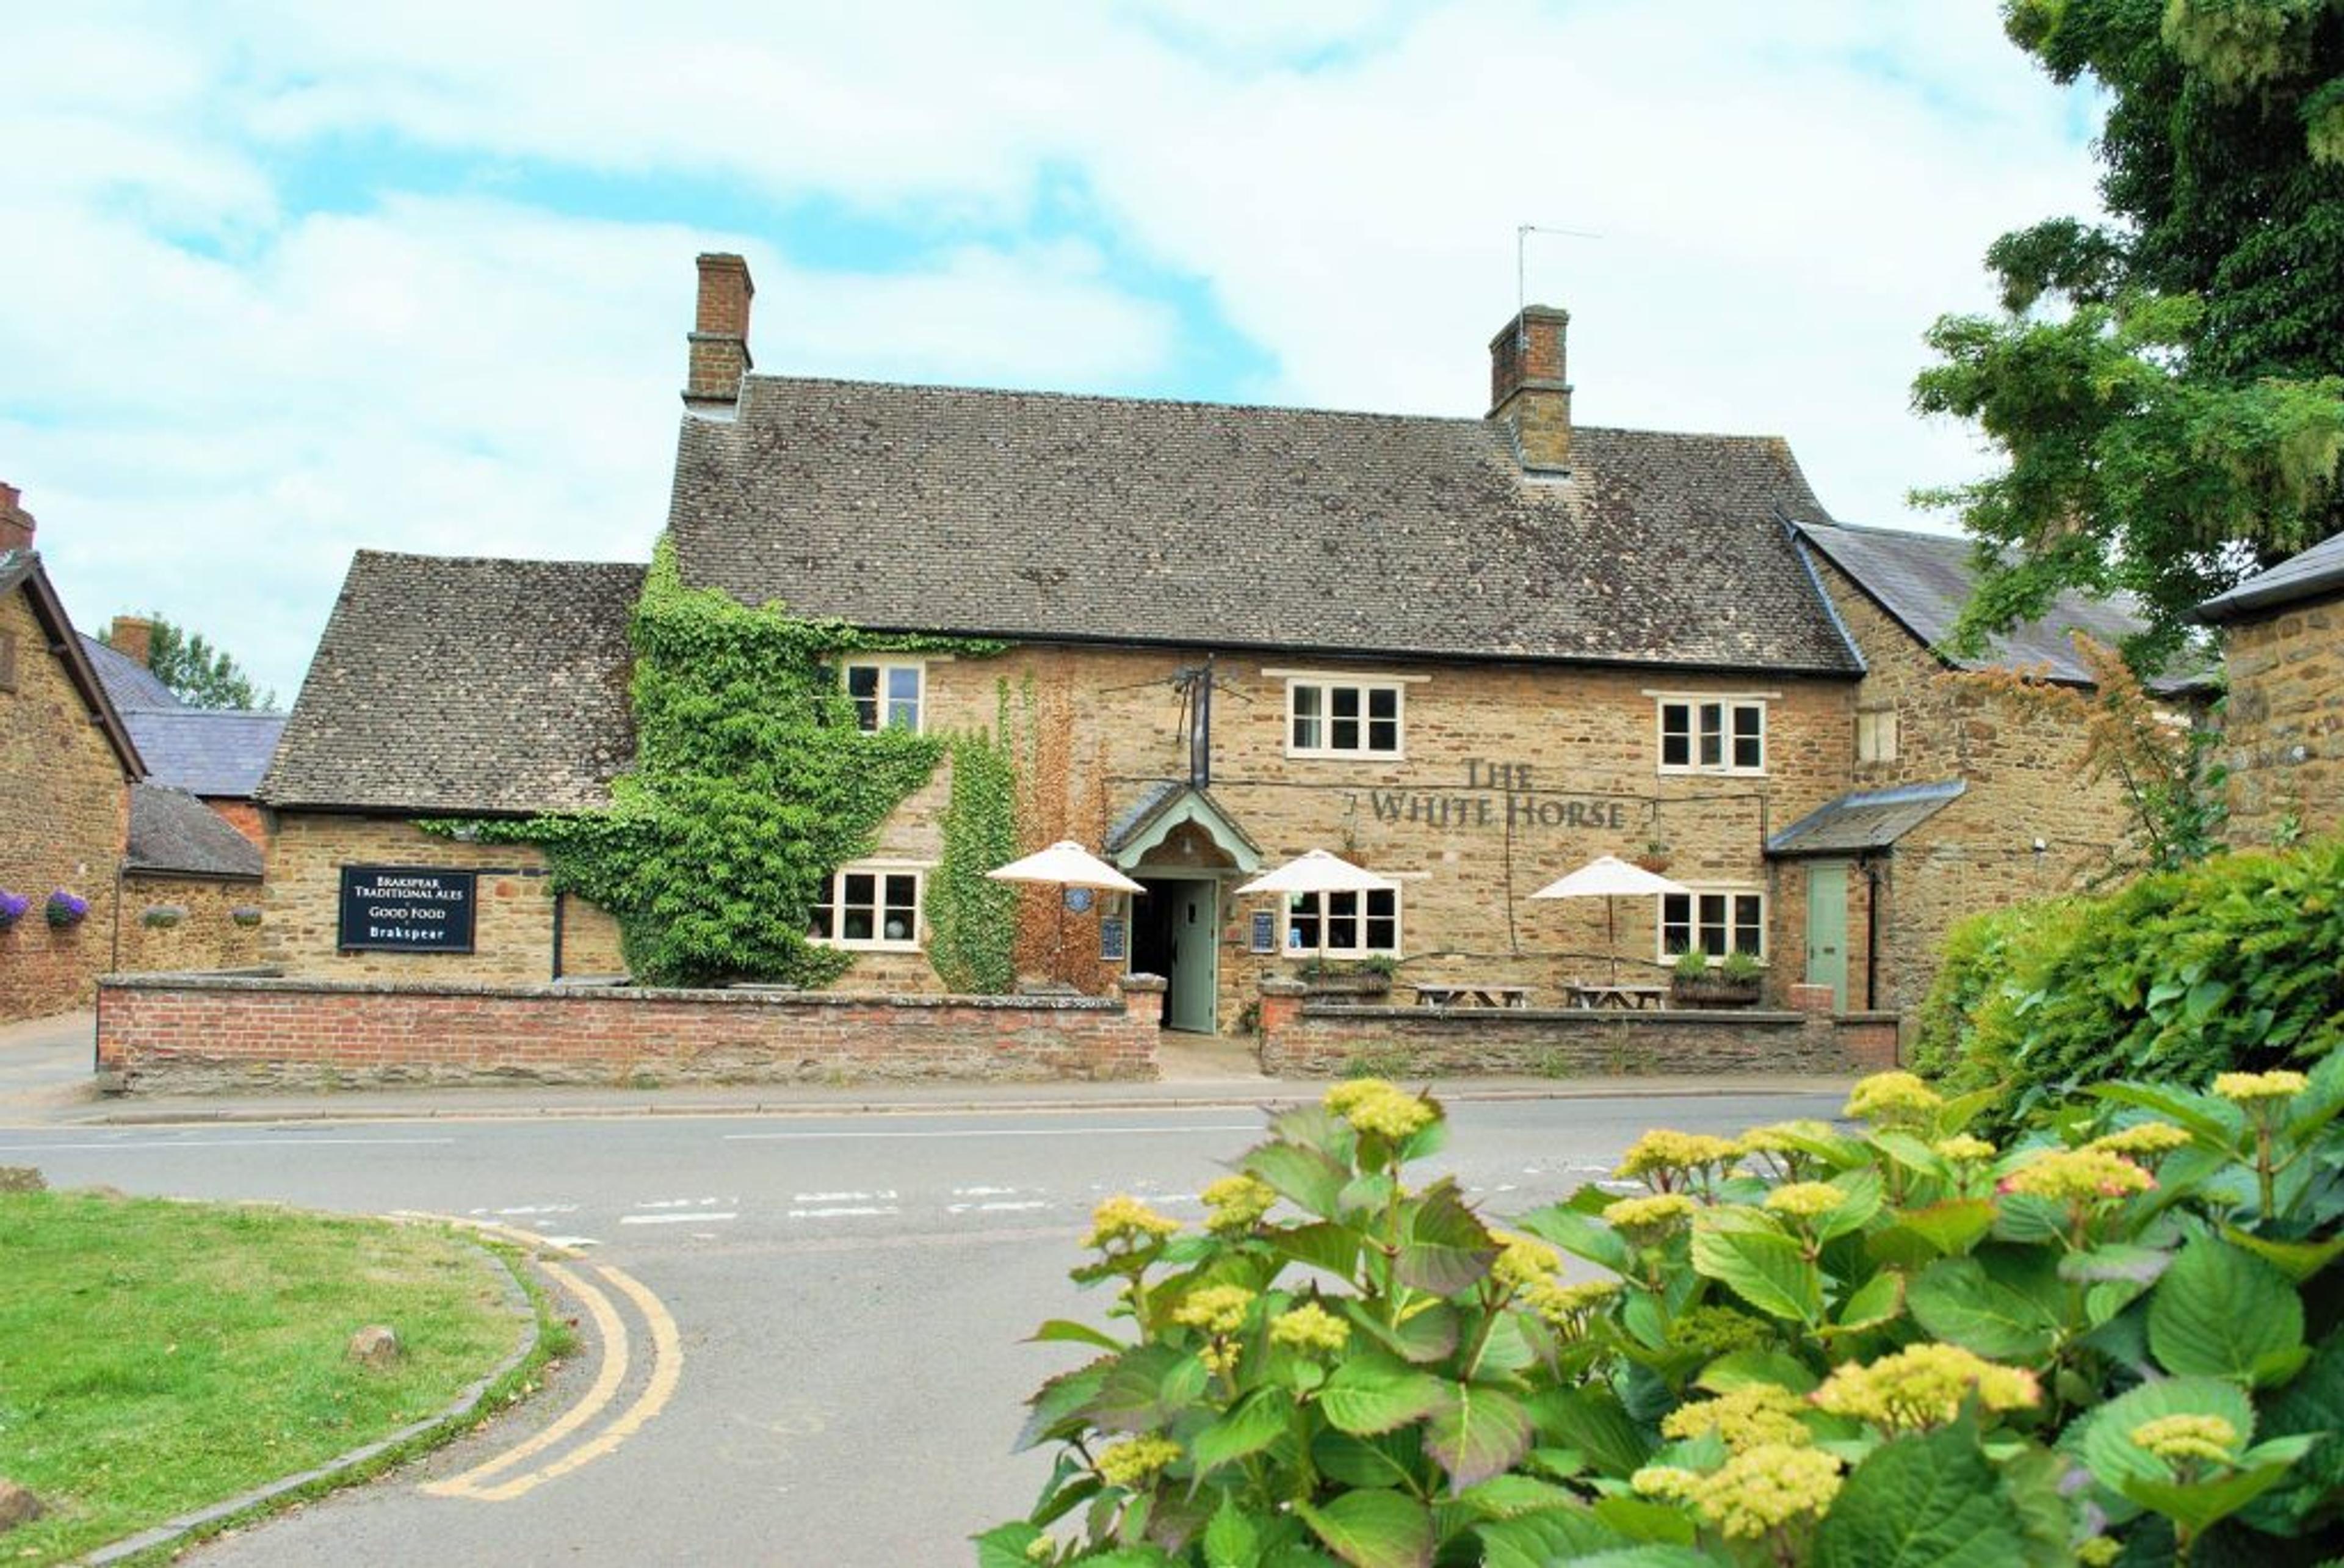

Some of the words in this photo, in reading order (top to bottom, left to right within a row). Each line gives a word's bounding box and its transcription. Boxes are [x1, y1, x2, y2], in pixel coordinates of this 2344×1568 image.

[1462, 757, 1533, 789] THE
[1371, 790, 1493, 826] WHITE
[1507, 795, 1626, 829] HORSE
[377, 876, 440, 889] BRAKSPEAR
[355, 886, 433, 898] TRADITIONAL
[435, 889, 464, 900] ALES
[369, 906, 408, 919] GOOD
[411, 908, 446, 919] FOOD
[370, 927, 445, 941] Brakspear
